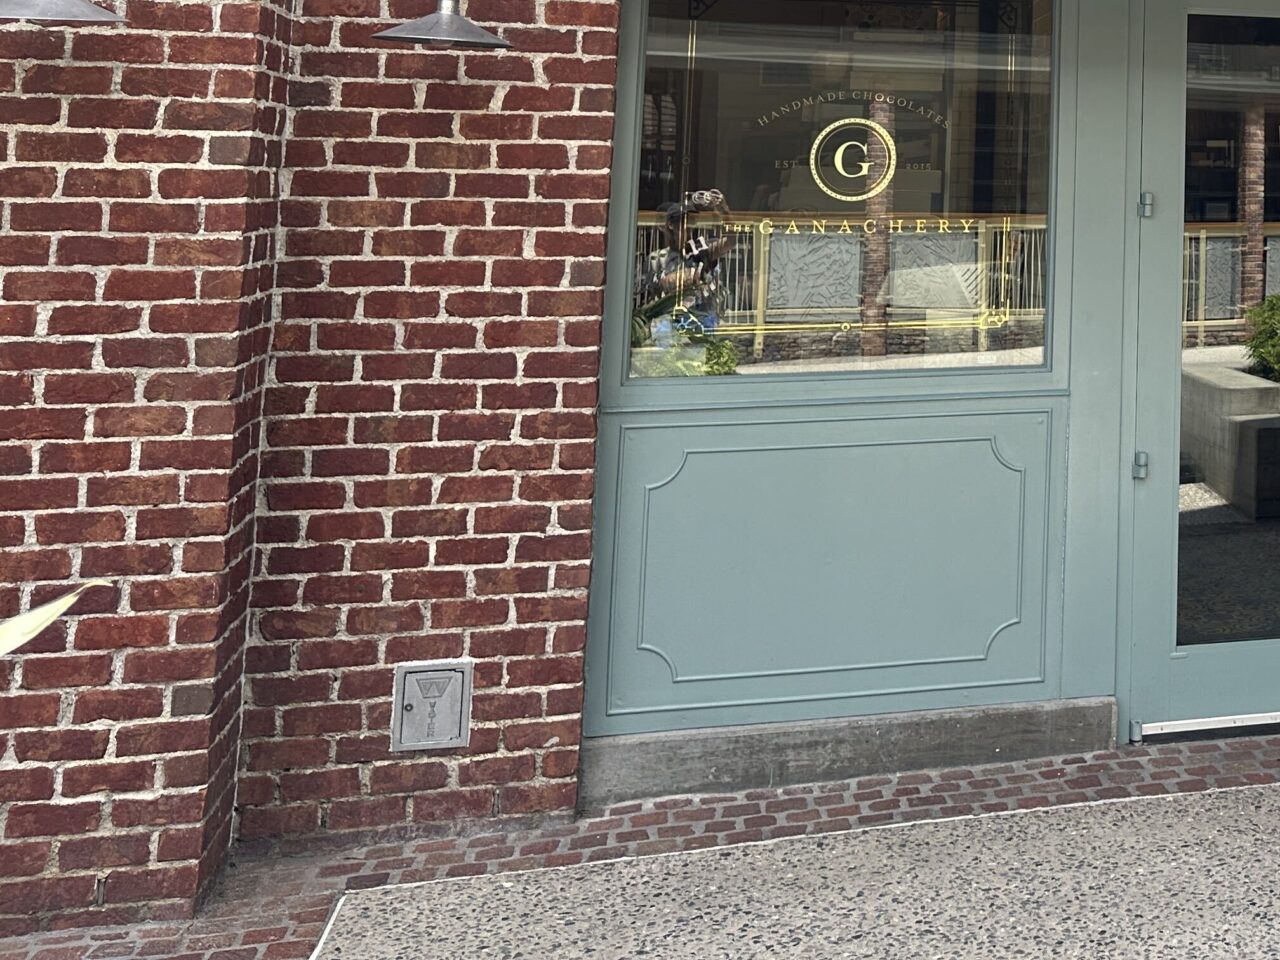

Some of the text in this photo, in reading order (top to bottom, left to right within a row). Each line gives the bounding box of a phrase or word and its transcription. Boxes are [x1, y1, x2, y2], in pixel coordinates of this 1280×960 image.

[757, 90, 950, 129] HANDMADE CHOCOLATES
[834, 141, 875, 178] G
[724, 224, 751, 233] THE
